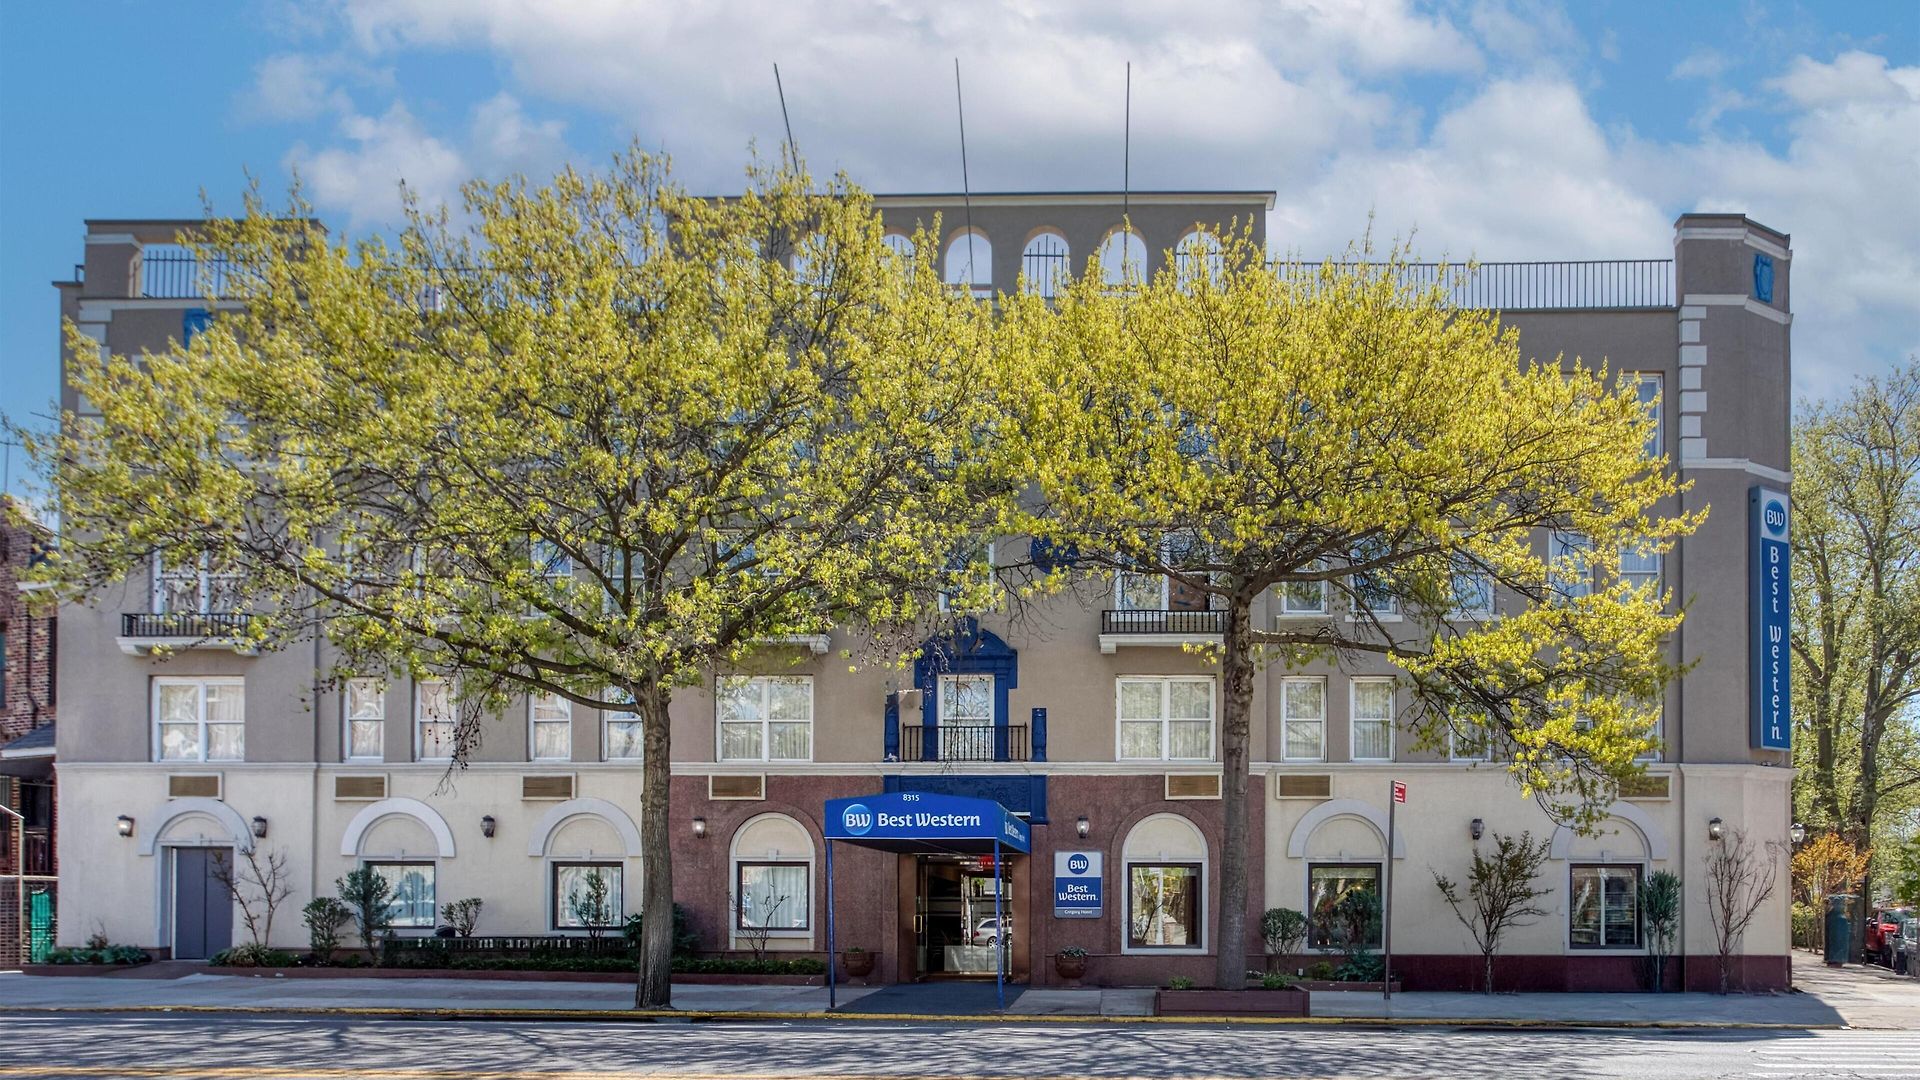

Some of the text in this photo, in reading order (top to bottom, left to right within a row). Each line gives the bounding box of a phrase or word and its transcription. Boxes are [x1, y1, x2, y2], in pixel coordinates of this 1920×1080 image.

[1766, 509, 1784, 527] BW
[1769, 545, 1780, 613] Best
[902, 793, 920, 802] 8315
[845, 812, 981, 827] BW Best Western
[1070, 860, 1088, 870] BW
[1067, 884, 1088, 893] Best
